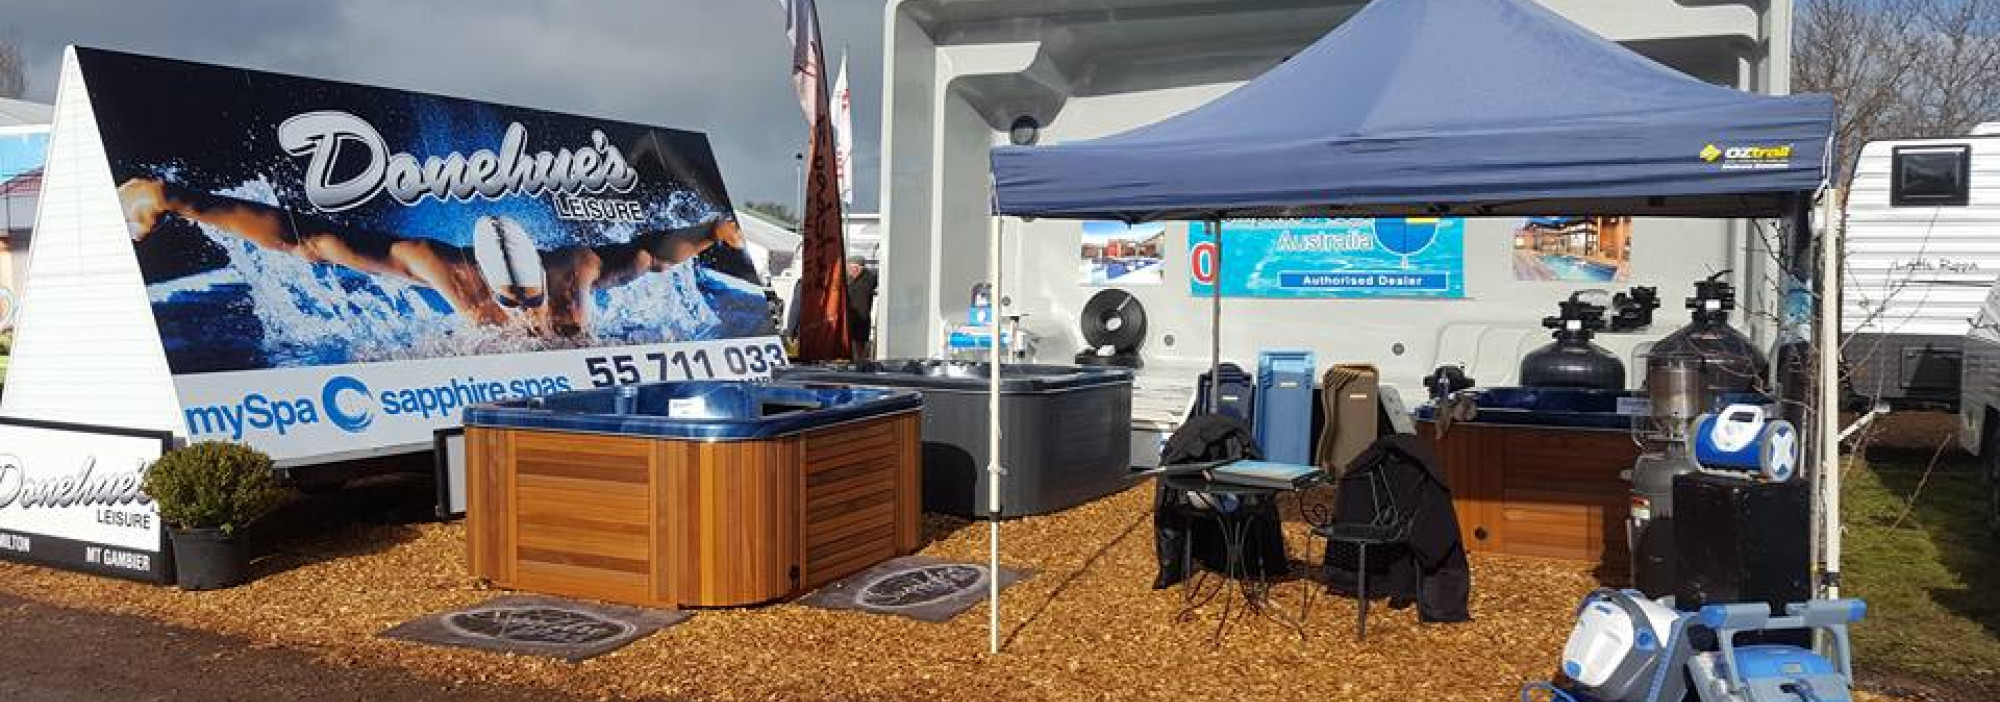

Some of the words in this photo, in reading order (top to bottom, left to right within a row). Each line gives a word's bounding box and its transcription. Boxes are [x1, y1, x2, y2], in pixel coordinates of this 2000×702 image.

[278, 109, 638, 213] Donehue's
[554, 198, 643, 221] LEISURE
[1277, 230, 1375, 251] Australia
[1303, 275, 1373, 286] Authorised
[1379, 275, 1422, 286] Dealer
[585, 354, 641, 388] 55
[645, 349, 715, 382] 711
[724, 343, 787, 376] 033
[382, 377, 505, 416] sapphire
[509, 376, 571, 399] spas
[184, 392, 319, 441] mySpa
[97, 509, 151, 529] LEISURE
[103, 548, 151, 571] GAMBIER
